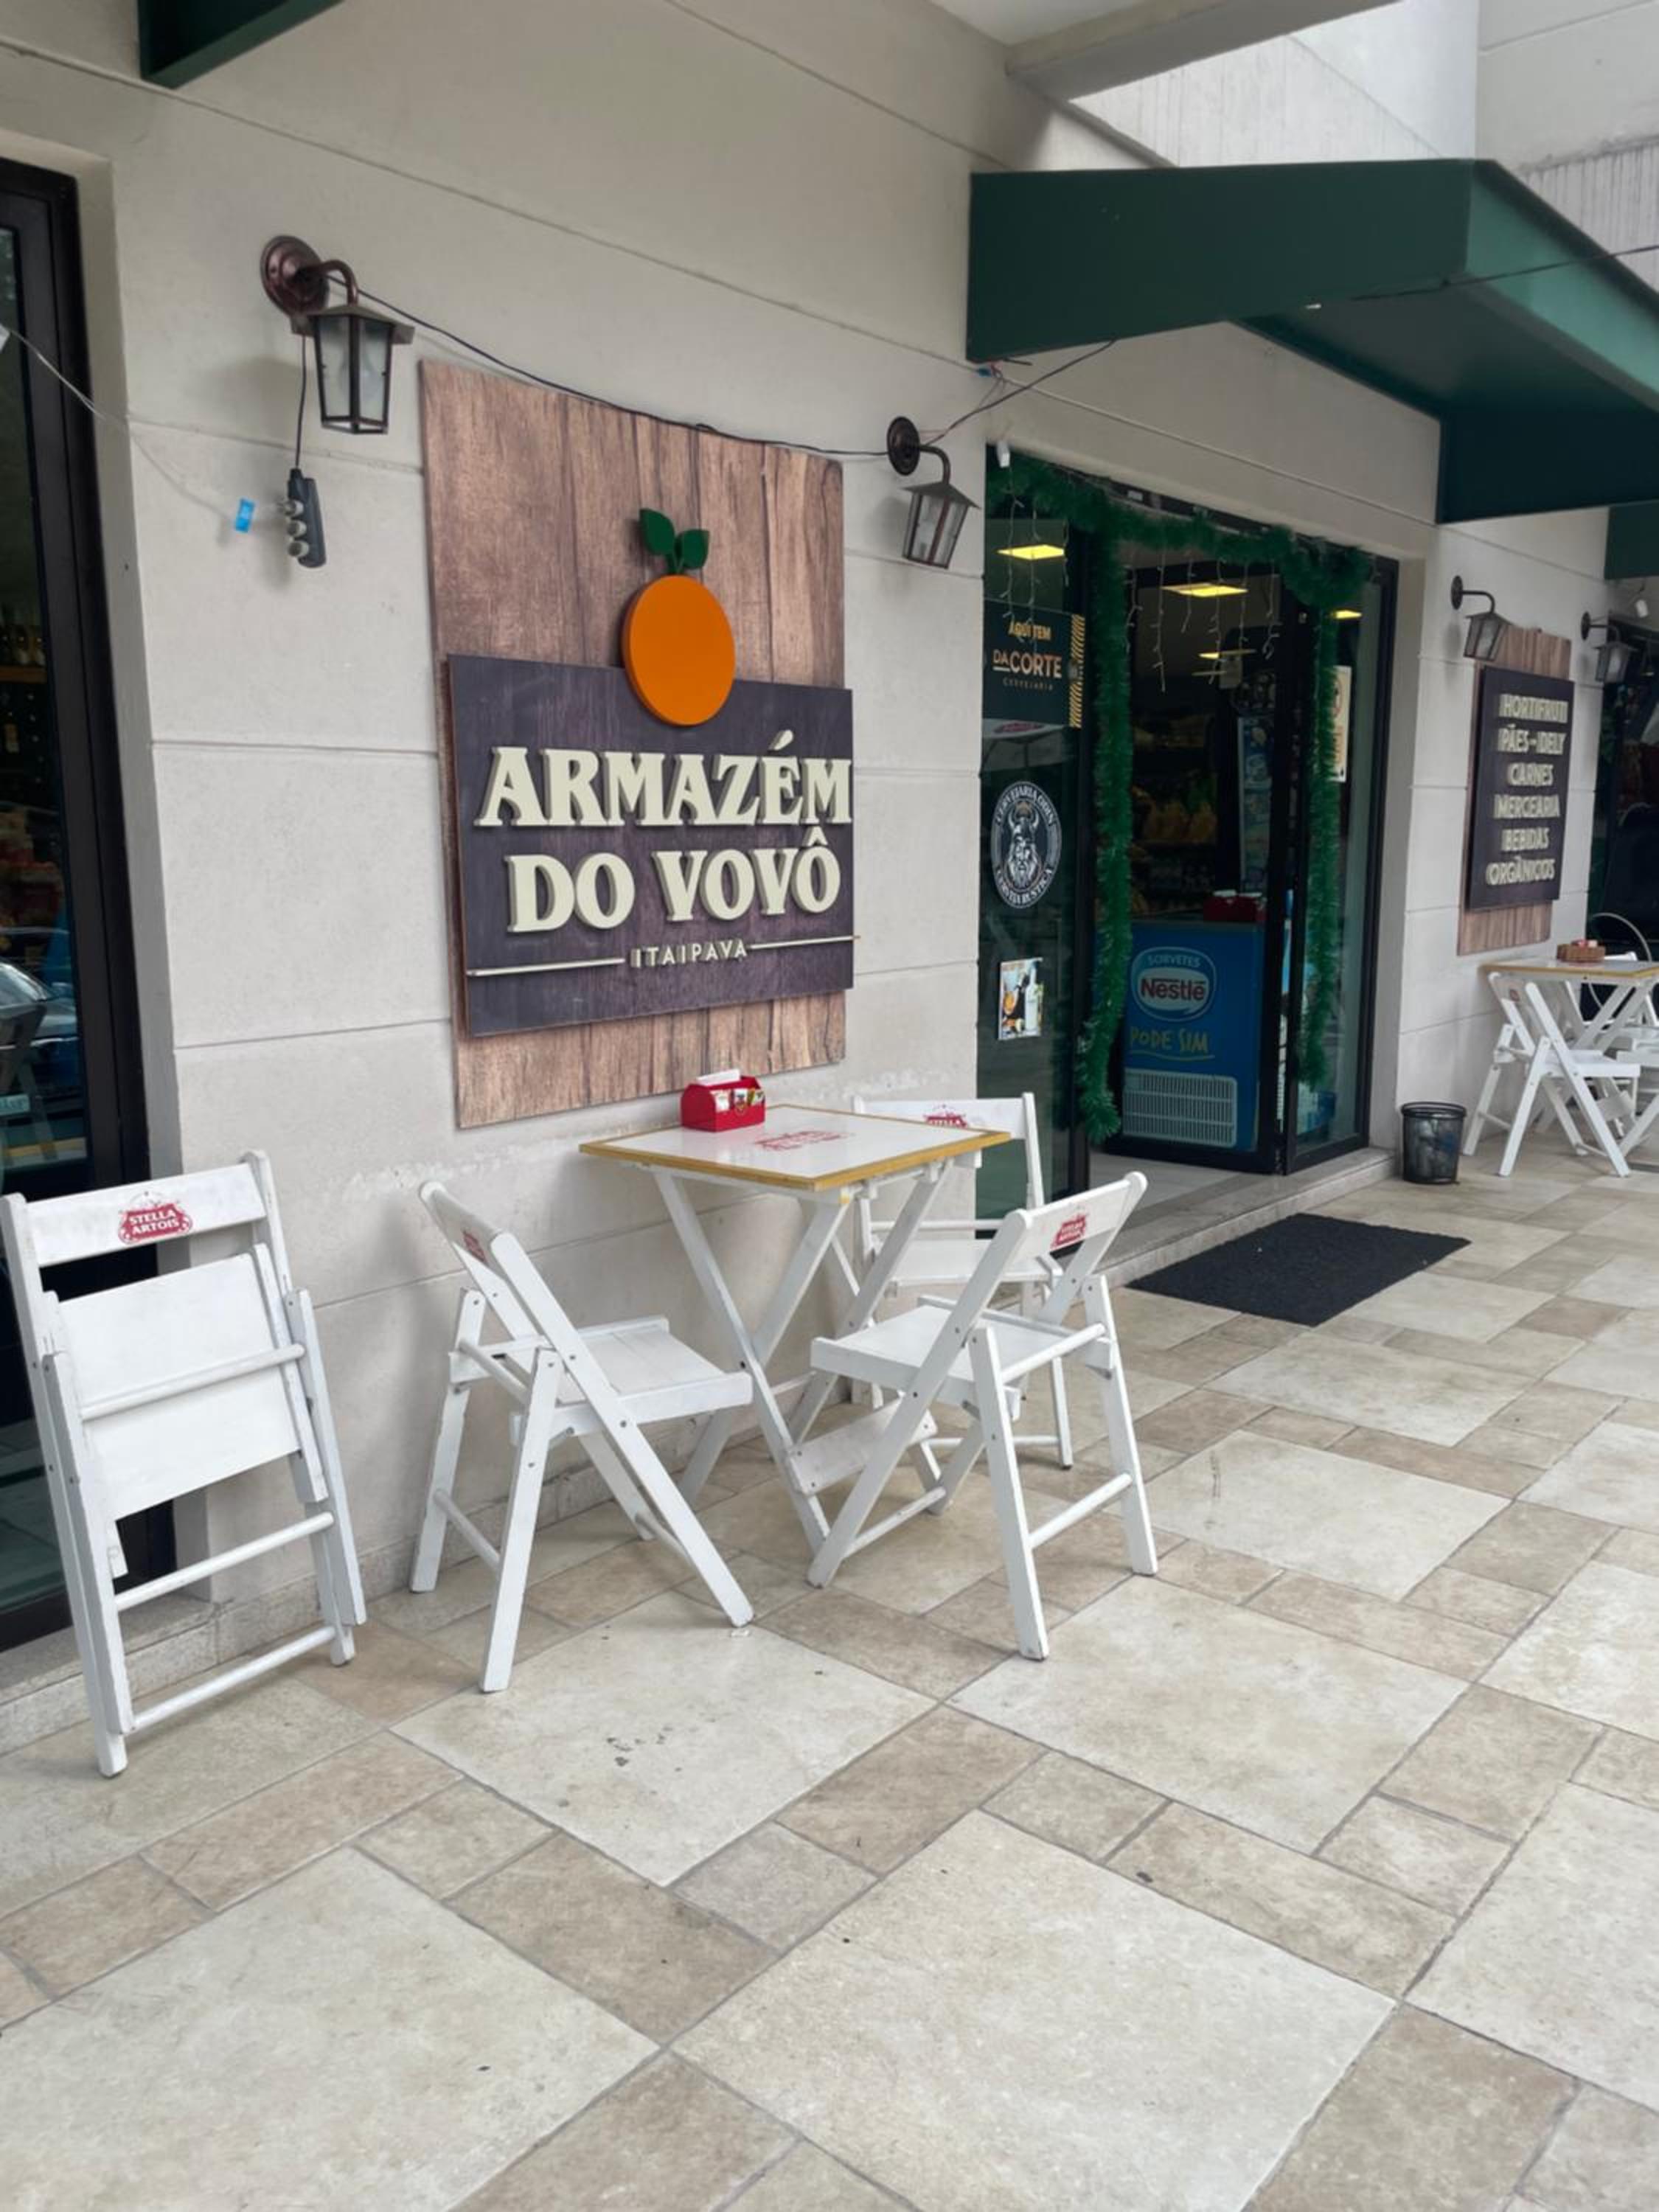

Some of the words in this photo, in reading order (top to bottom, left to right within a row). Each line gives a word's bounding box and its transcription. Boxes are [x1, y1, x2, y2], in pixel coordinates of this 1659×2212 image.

[1032, 625, 1051, 640] TEM
[1498, 694, 1568, 723] HORTIFRUTI
[473, 729, 852, 827] ARMAZÉM
[1507, 762, 1554, 786] CARNES
[1493, 794, 1560, 818] MERCEARIA
[1501, 827, 1550, 852] BEBIDAS
[504, 852, 635, 933] DO
[652, 827, 841, 922] VOVÔ
[1486, 856, 1556, 885] ORGÂNICOS
[630, 939, 747, 968] ITAIPAVA
[1148, 954, 1202, 968] SORVETES
[129, 1208, 177, 1225] STELLA
[133, 1219, 180, 1234] ARTOIS
